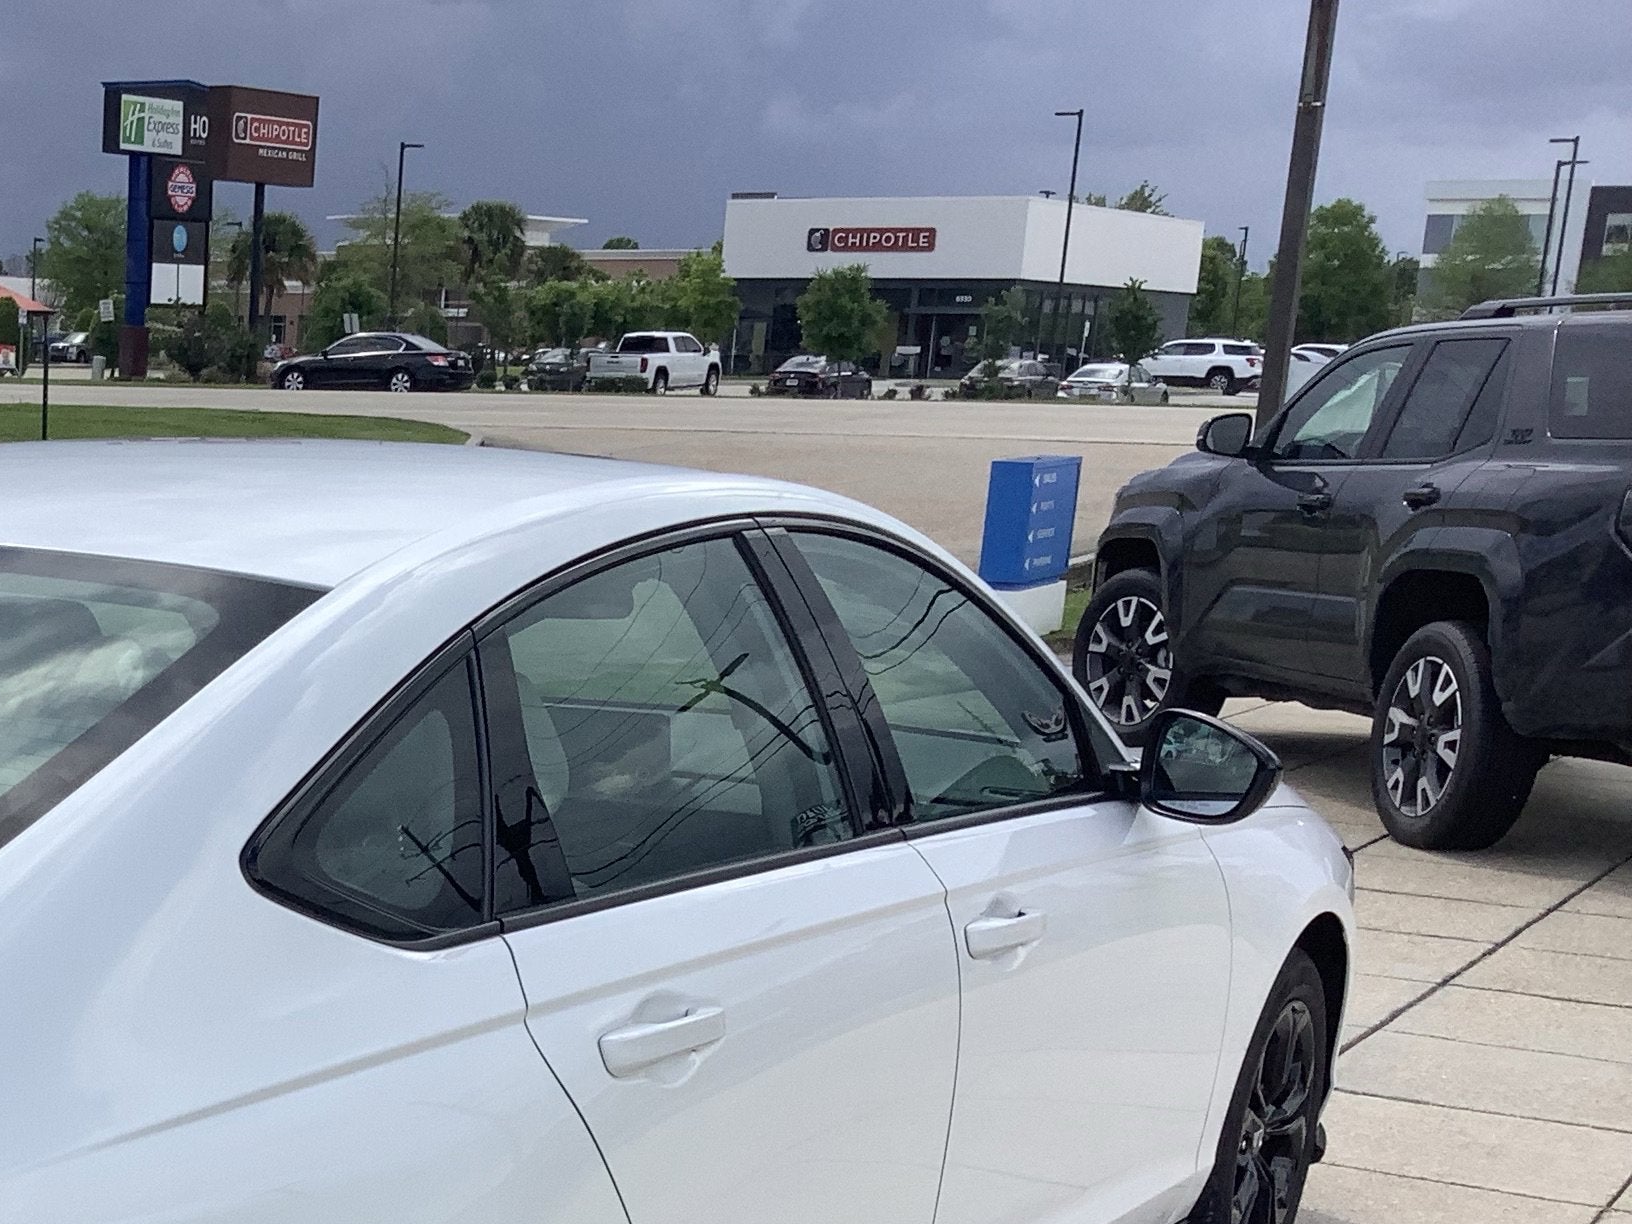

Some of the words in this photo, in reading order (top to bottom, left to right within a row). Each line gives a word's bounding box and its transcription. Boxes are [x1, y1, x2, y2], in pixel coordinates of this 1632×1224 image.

[146, 115, 180, 135] Express
[251, 121, 309, 143] CHIPOTLE
[258, 148, 287, 159] MEXICAN
[288, 151, 307, 161] GRILL
[169, 183, 195, 195] GENESIS
[834, 231, 930, 248] CHIPOTLE
